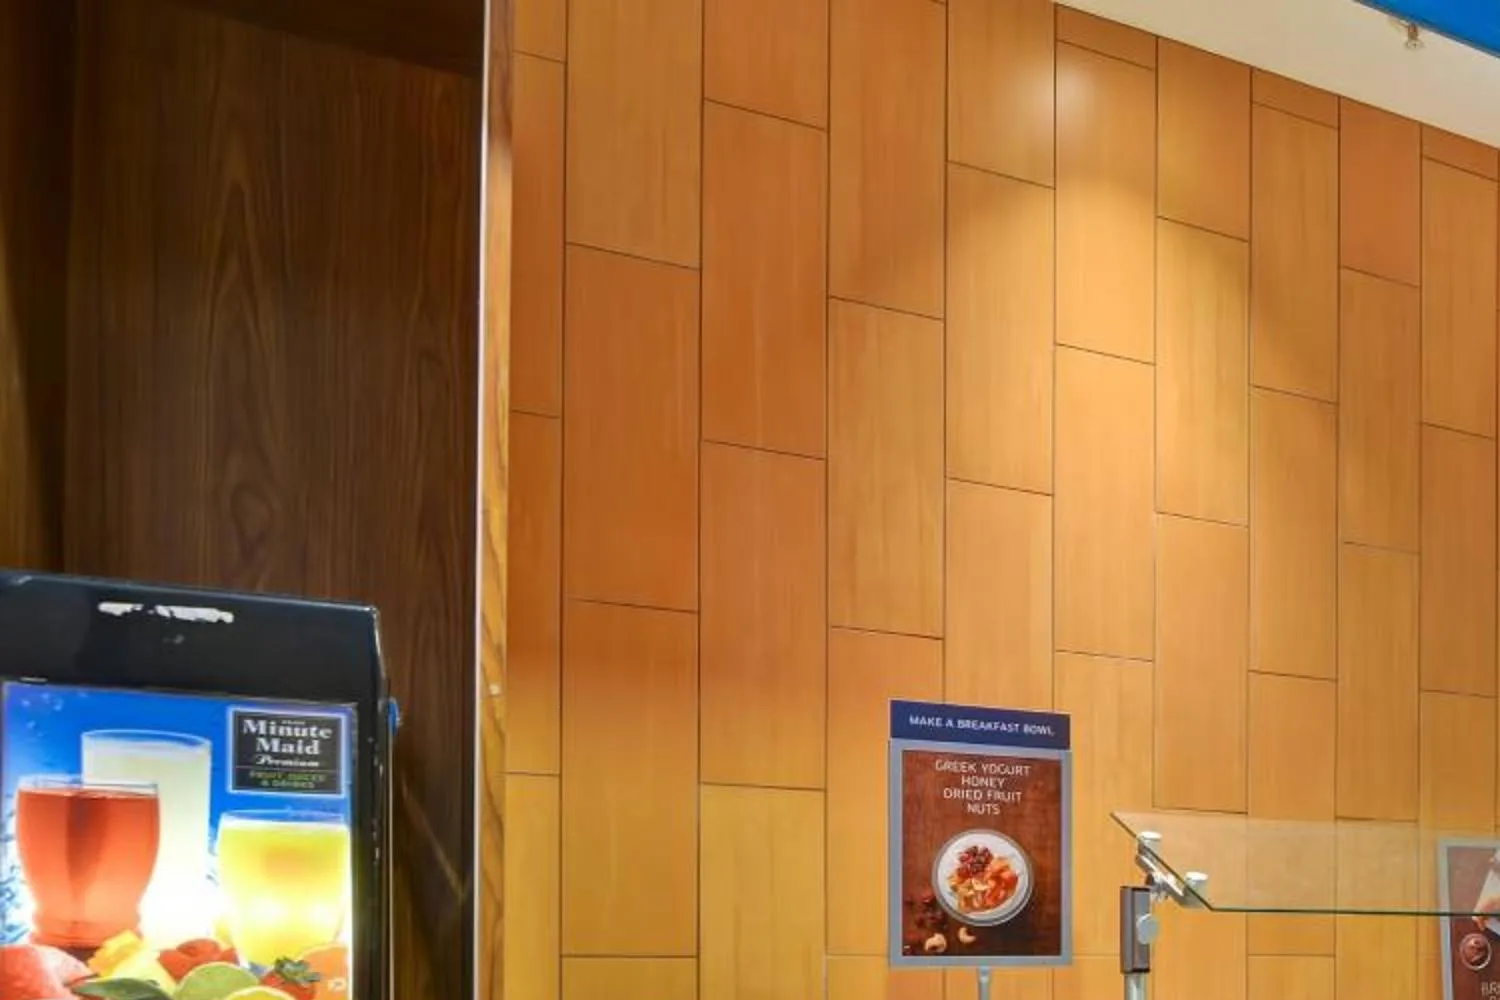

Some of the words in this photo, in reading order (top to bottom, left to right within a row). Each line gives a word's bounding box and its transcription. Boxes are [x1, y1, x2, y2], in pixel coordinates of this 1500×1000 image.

[243, 719, 333, 739] Minute
[909, 714, 942, 727] MAKE
[945, 717, 953, 728] A
[957, 719, 1019, 733] BREAKFAST
[256, 737, 320, 755] Maid
[935, 759, 977, 773] GREEK
[981, 763, 1031, 777] YOGURT
[961, 776, 1005, 789] HONEY
[943, 788, 983, 801] DRIED
[987, 791, 1022, 803] FRUIT
[967, 803, 1001, 815] NUTS
